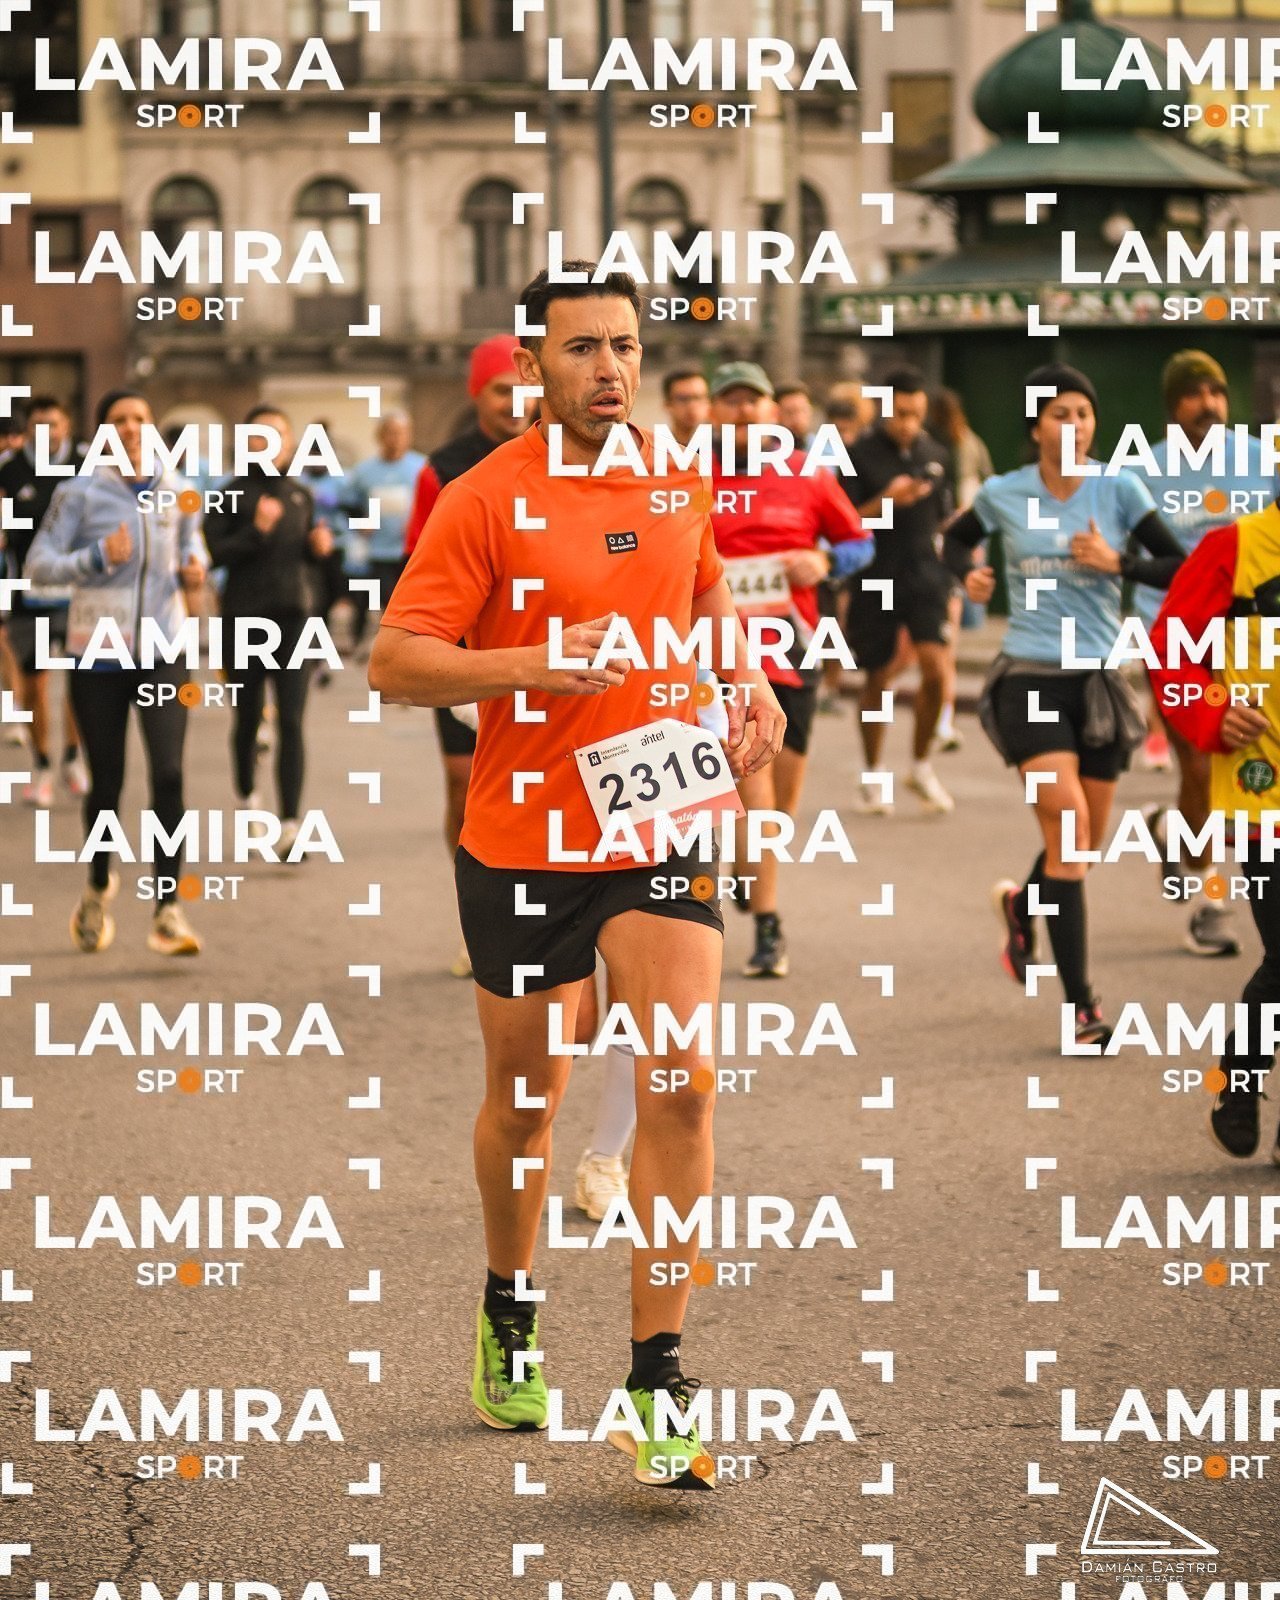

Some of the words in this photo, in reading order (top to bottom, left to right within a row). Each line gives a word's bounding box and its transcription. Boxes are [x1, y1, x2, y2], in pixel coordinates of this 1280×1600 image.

[726, 573, 783, 595] 444
[640, 730, 665, 747] antel
[602, 748, 630, 761] Montevideo
[599, 741, 721, 814] 2316
